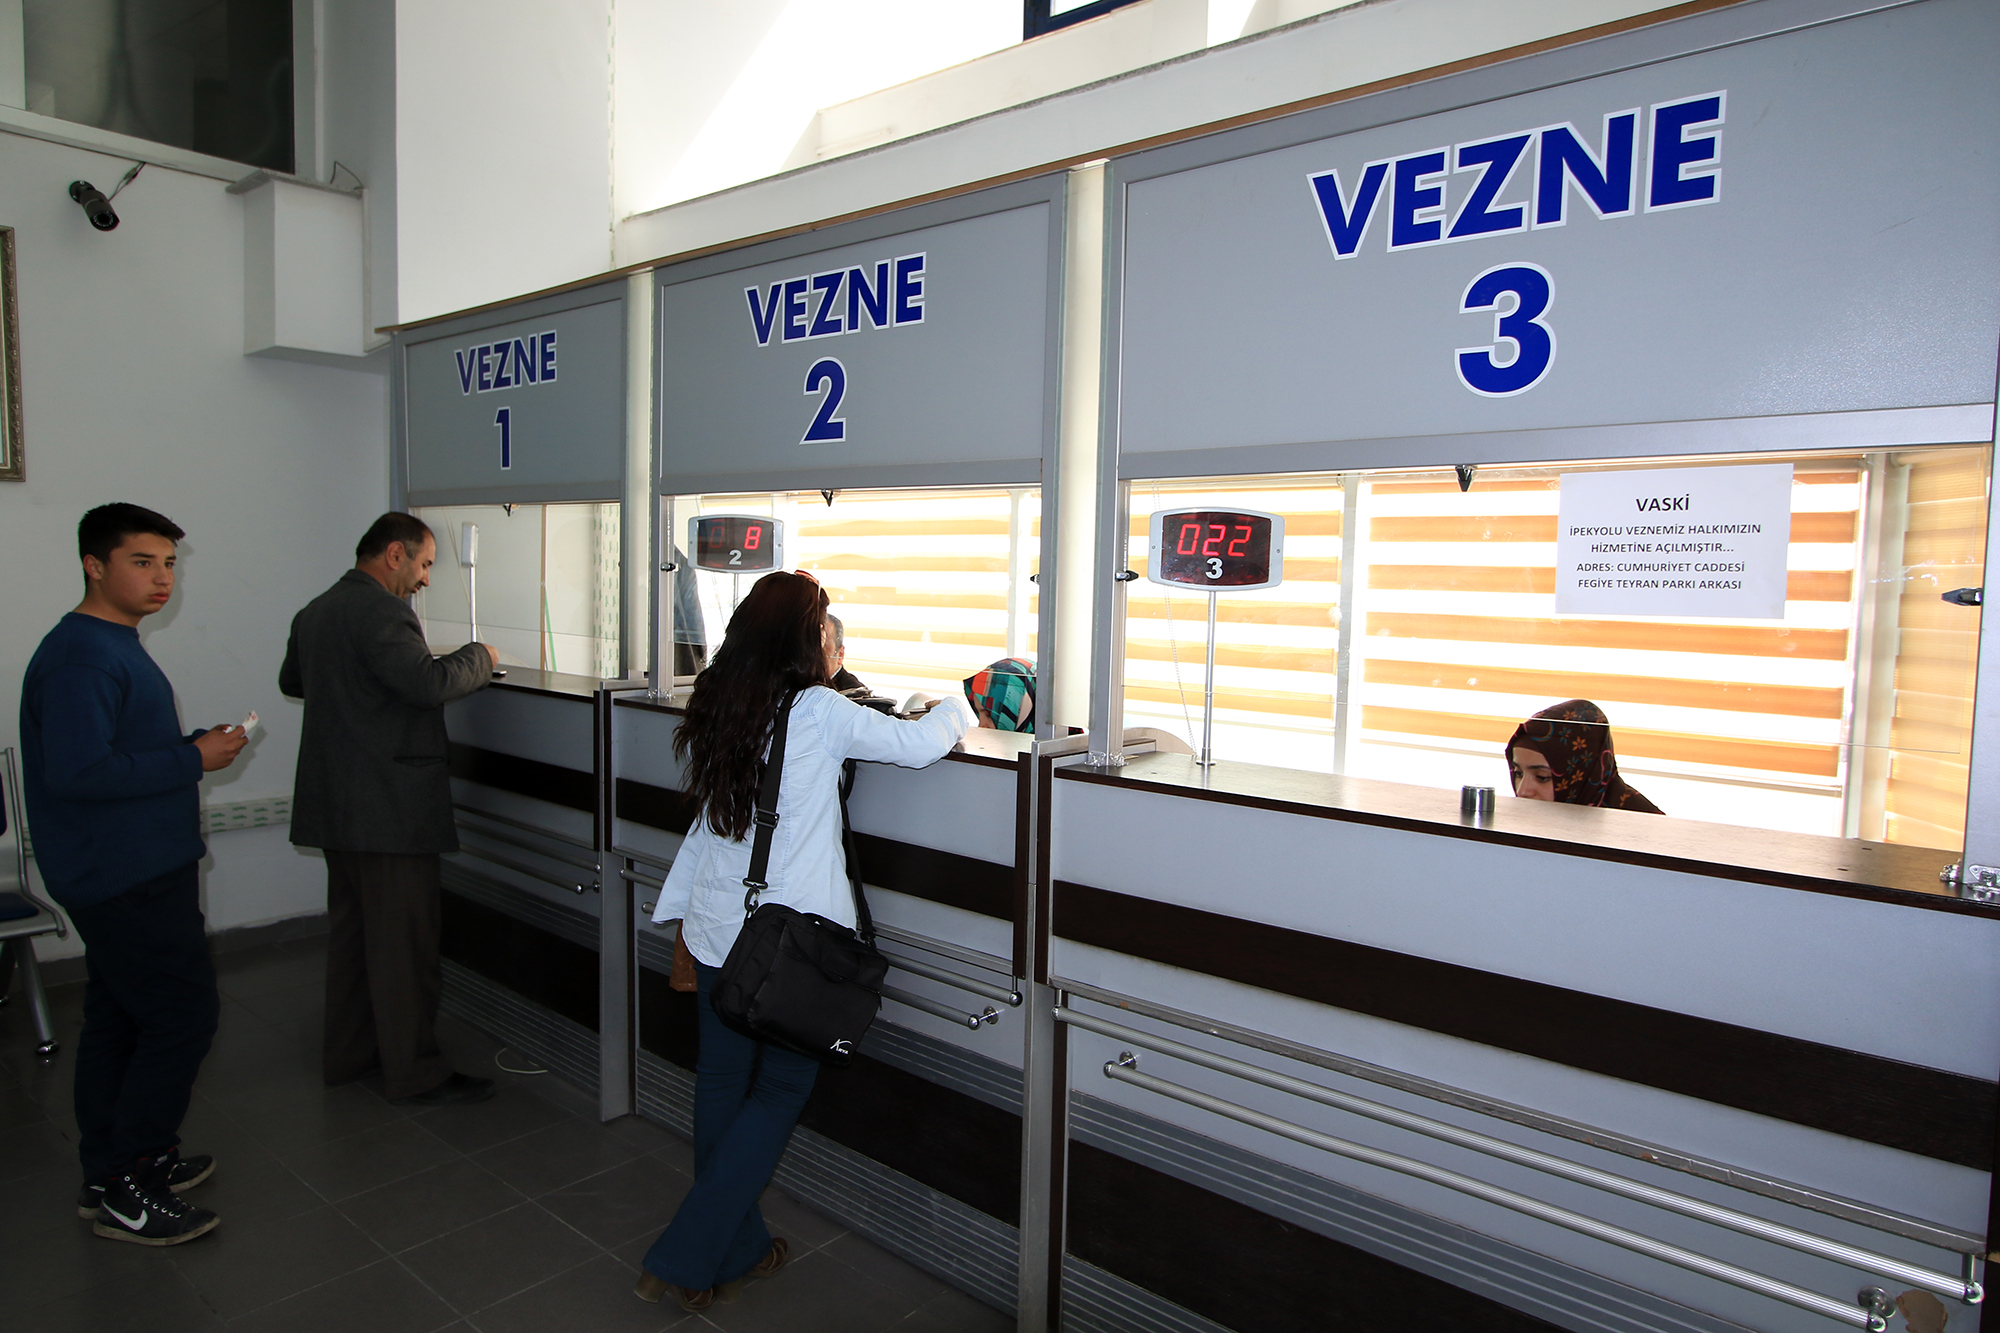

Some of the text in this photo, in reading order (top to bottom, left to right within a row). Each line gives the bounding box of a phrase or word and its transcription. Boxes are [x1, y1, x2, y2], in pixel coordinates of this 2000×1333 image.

[1306, 89, 1727, 260] VEZNE
[744, 251, 927, 347] VEZNE
[1455, 262, 1557, 398] 3
[454, 329, 558, 395] VEZNE
[799, 356, 847, 444] 2
[493, 407, 511, 470] 1
[1635, 493, 1690, 512] VASKİ
[1176, 523, 1253, 557] 022
[1569, 523, 1762, 537] İPEKYOLU VEZNEMİZ HALKIMIZIN
[728, 549, 742, 565] 2
[1591, 541, 1735, 555] HİZMETİNE AÇILMIŞTIR...
[1205, 557, 1224, 580] 3
[1576, 561, 1745, 572] ADRES: CUMHURİYET CADDESİ
[1616, 579, 1659, 588] TEYRAN
[1662, 579, 1696, 589] PARKI
[1698, 580, 1742, 590] ARKASI
